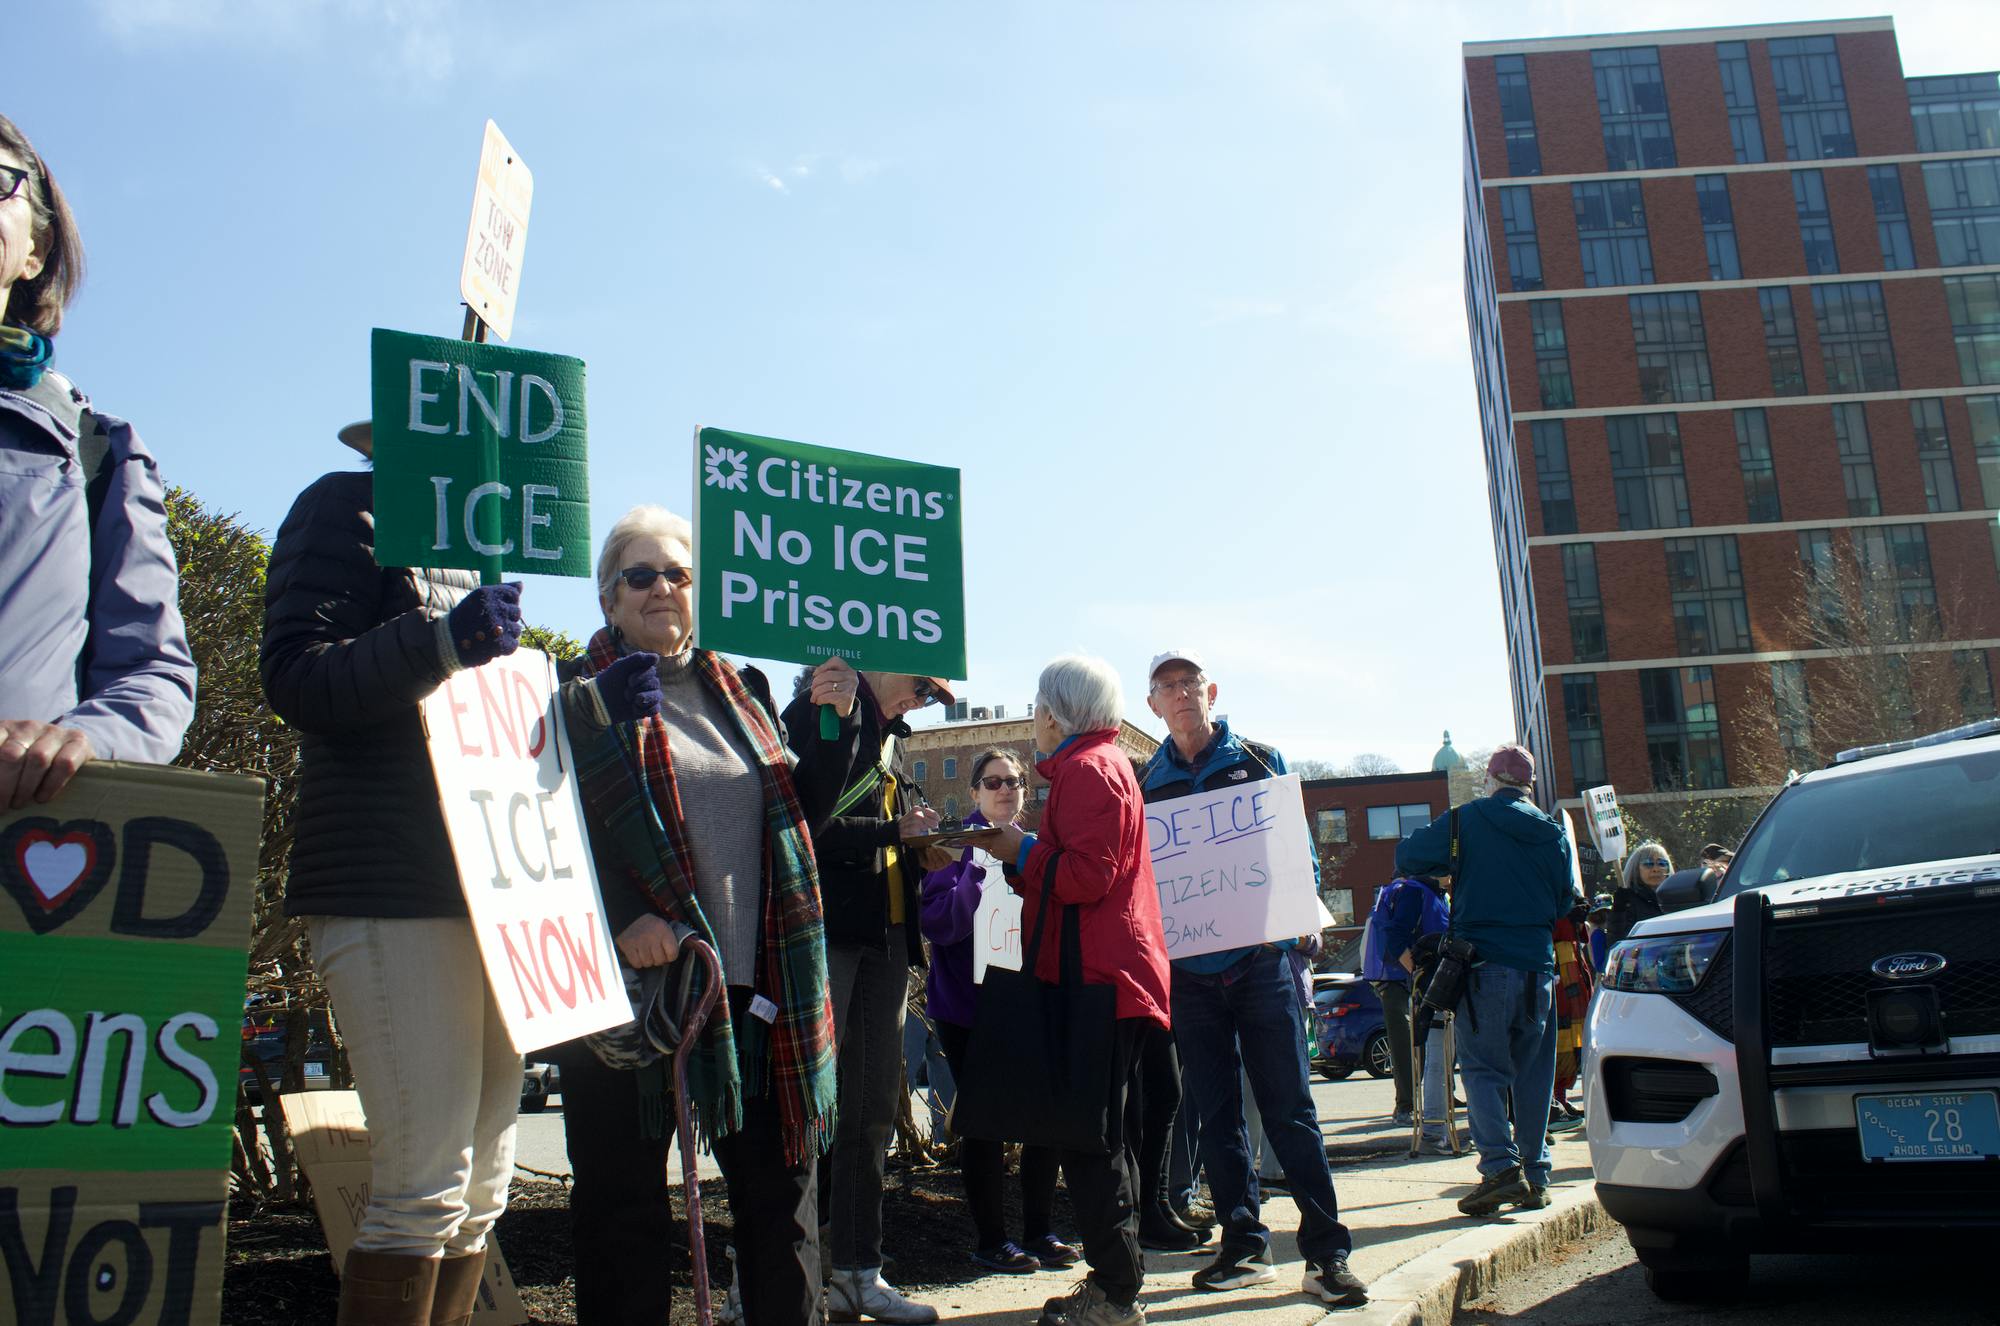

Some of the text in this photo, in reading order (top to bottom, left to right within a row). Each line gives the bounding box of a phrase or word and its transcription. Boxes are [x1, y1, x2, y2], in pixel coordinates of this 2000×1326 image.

[489, 197, 515, 251] TOW
[474, 231, 512, 296] ZONE
[407, 358, 564, 443] END
[429, 476, 563, 560] ICE
[757, 457, 944, 520] Citizens
[734, 510, 929, 582] No ICE
[721, 570, 943, 644] Prisons
[806, 645, 862, 660] INDIVISIBLE
[445, 665, 546, 760] END
[470, 789, 573, 889] ICE
[1145, 790, 1276, 852] DE-ICE
[1844, 871, 2000, 897] POLICE
[497, 911, 606, 1020] NOW
[1888, 955, 1928, 973] Ford
[1864, 1111, 1905, 1143] POLICE
[1887, 1097, 1964, 1108] OCEAN STATE
[1924, 1109, 1963, 1142] 28
[1894, 1144, 1972, 1156] RHODE ISLAND
